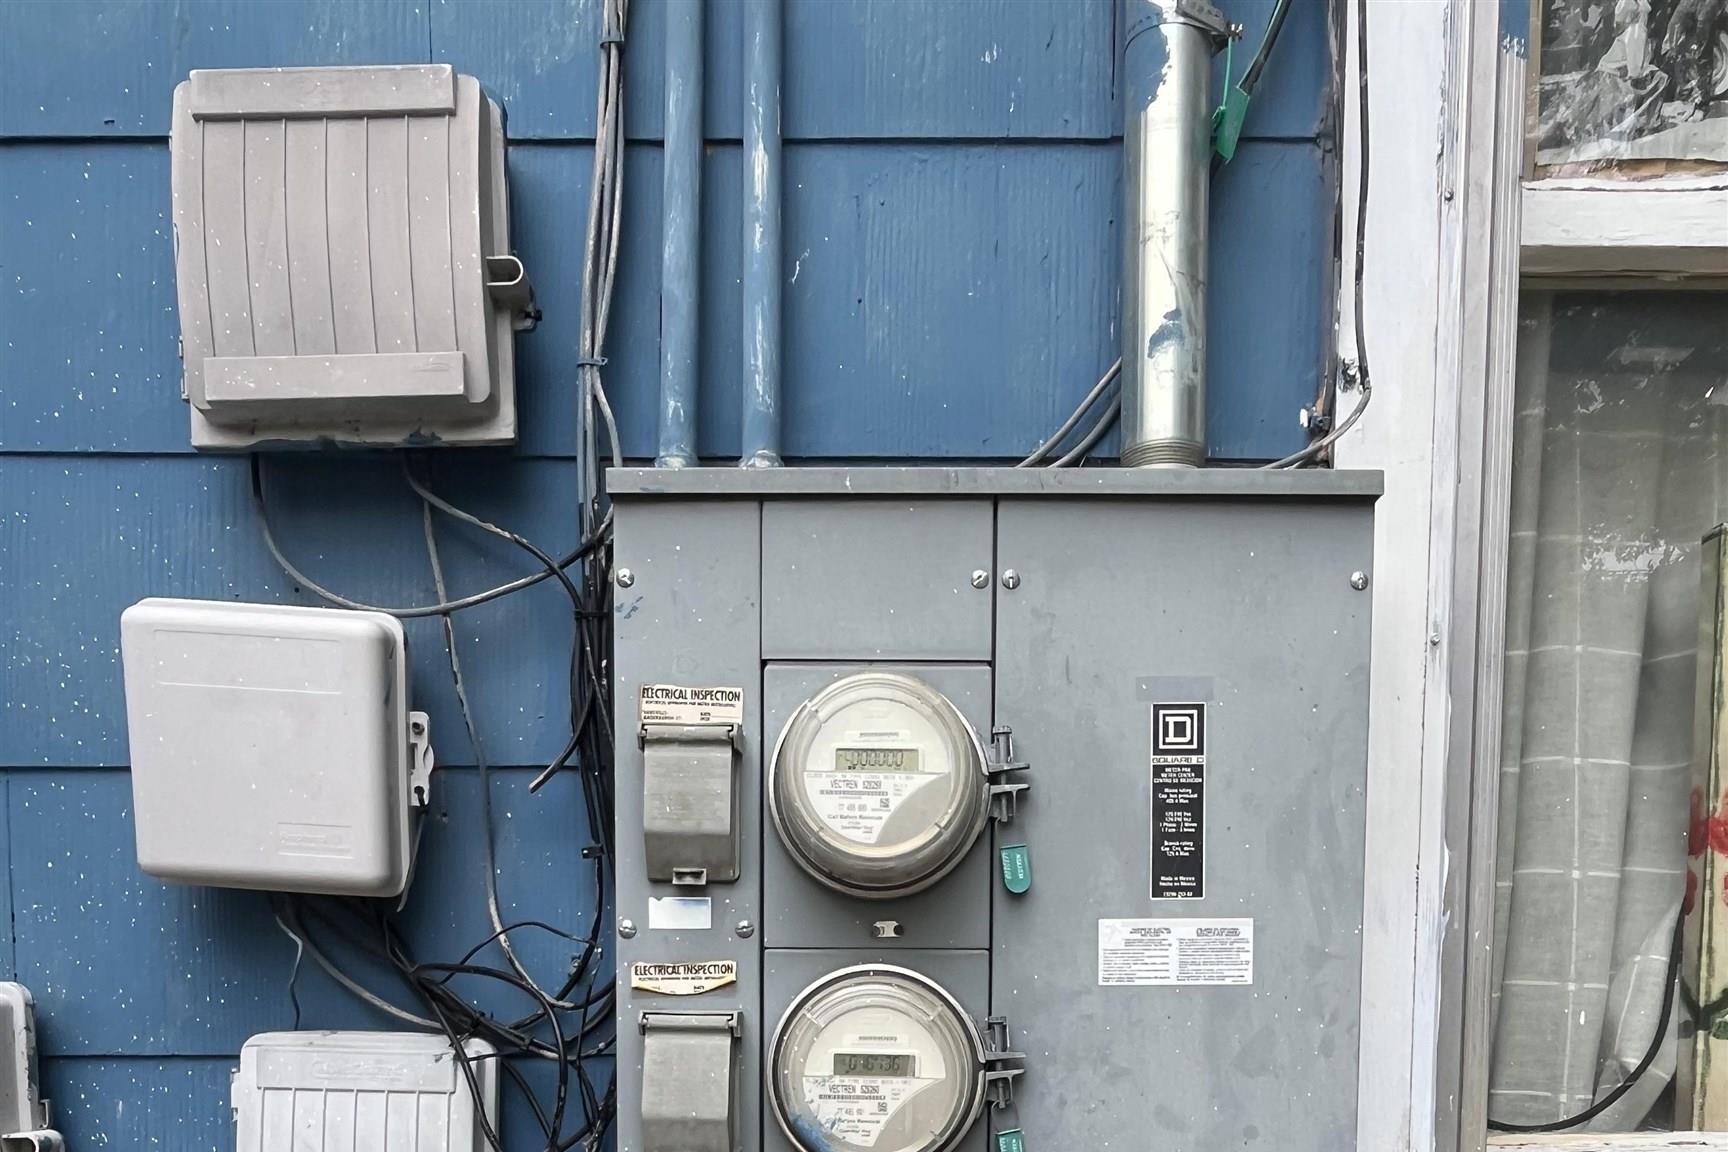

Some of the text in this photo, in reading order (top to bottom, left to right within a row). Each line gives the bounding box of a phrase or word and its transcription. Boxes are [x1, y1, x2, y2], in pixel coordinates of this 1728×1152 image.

[642, 687, 741, 702] ELECTRICAL INSPECTION
[1165, 716, 1191, 743] D
[634, 964, 734, 976] ELECTRICAL INSPECTION
[828, 1084, 856, 1094] VECTREN
